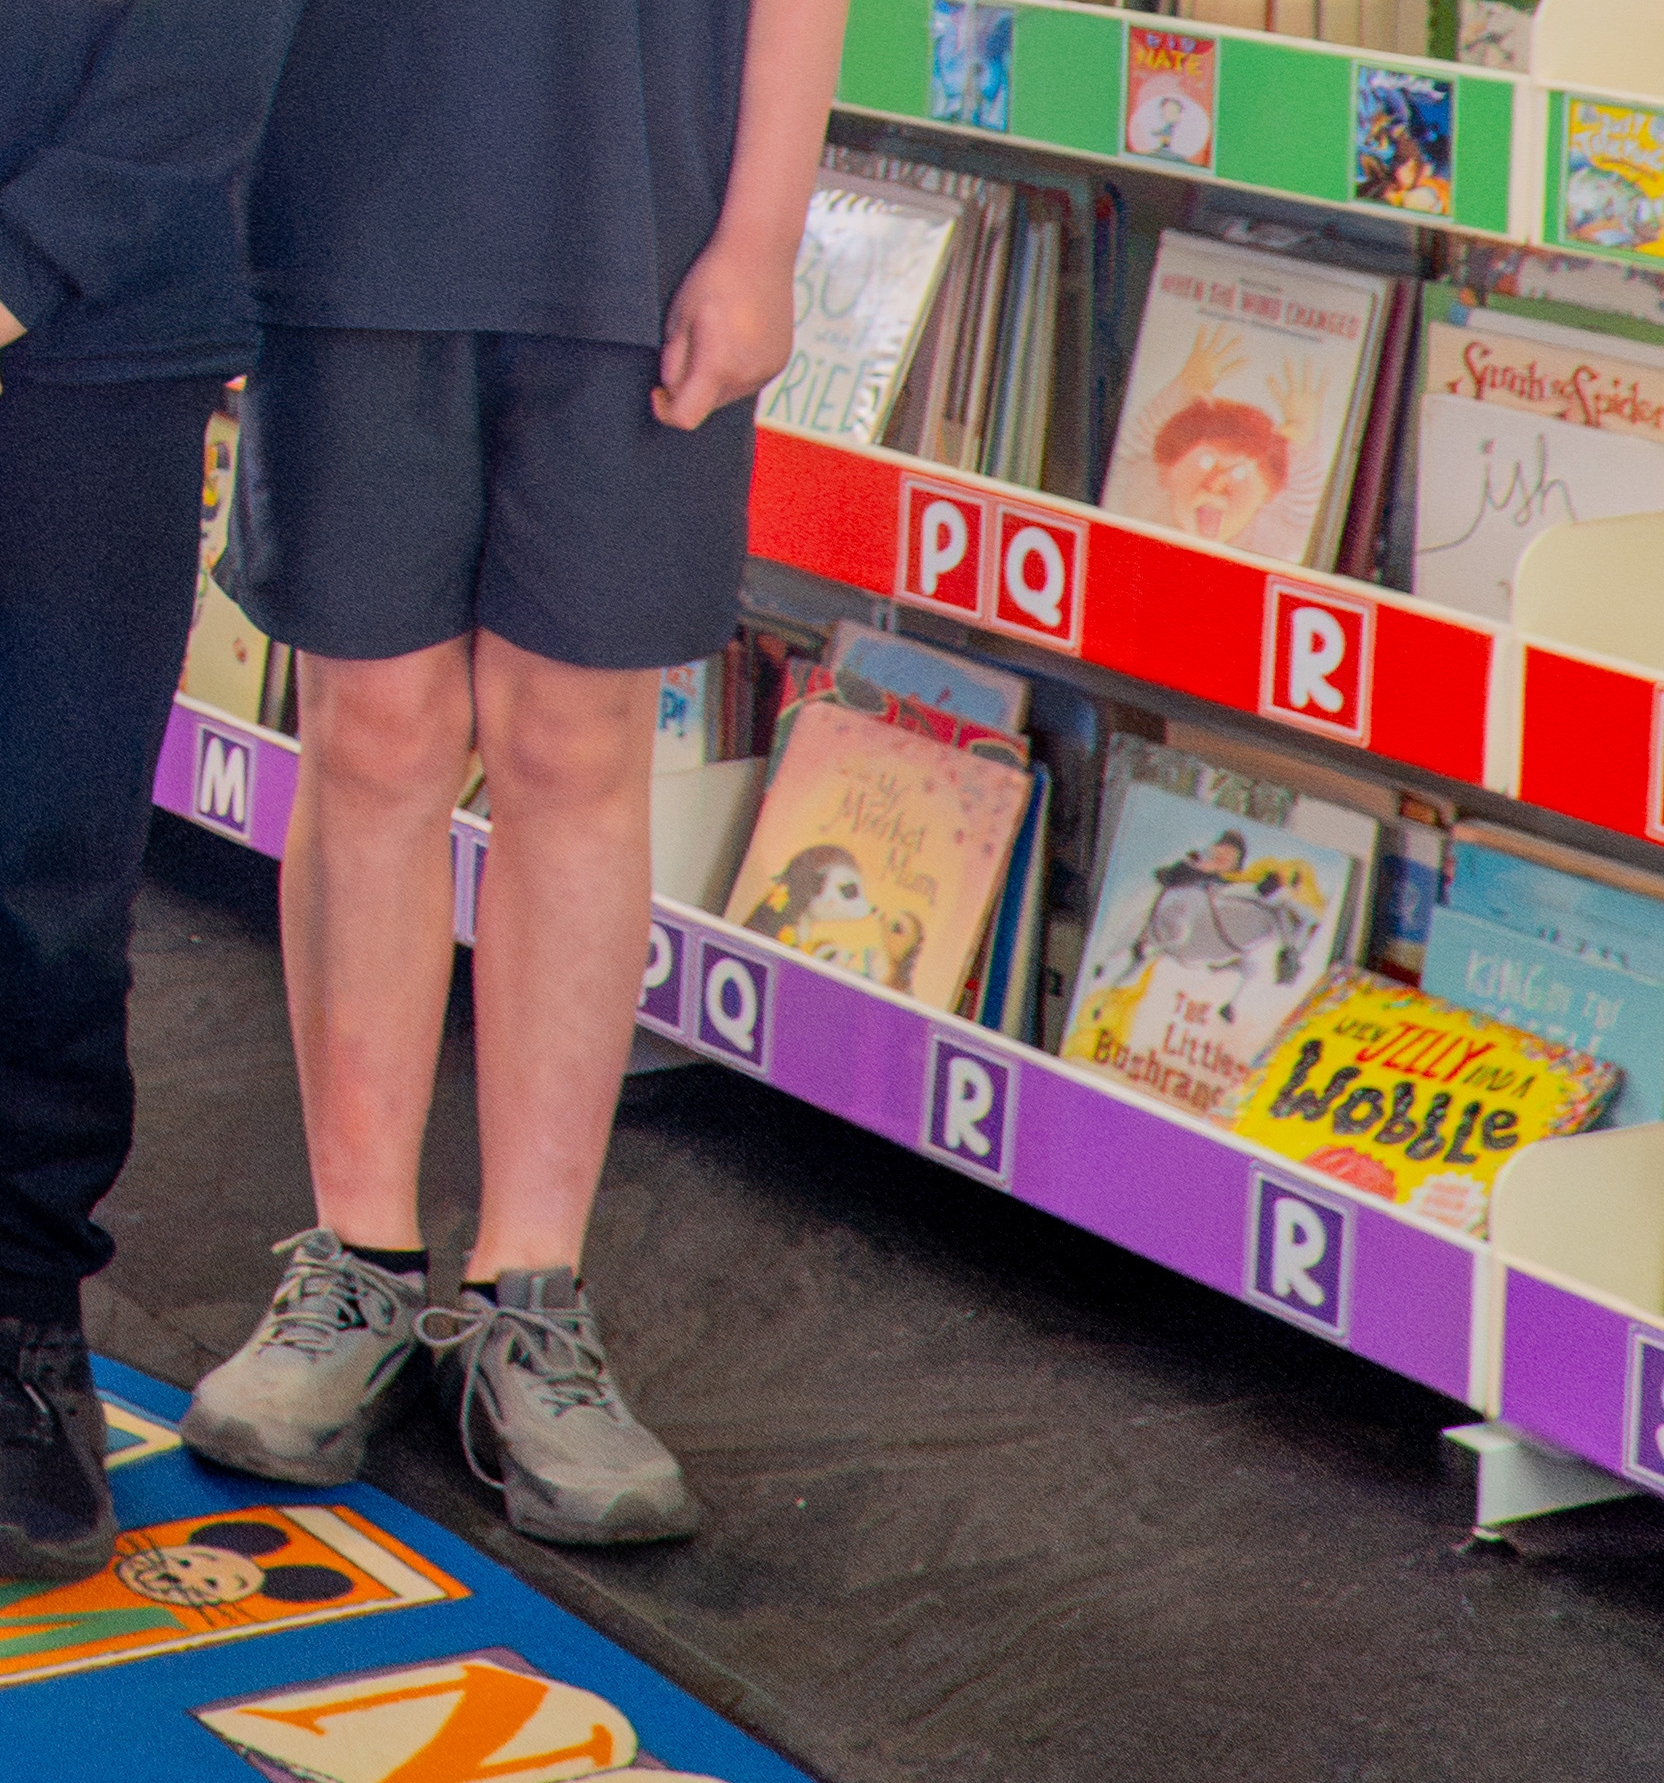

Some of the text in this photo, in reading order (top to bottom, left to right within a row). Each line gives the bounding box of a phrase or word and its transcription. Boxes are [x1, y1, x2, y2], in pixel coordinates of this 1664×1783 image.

[1133, 48, 1205, 76] NATE
[918, 500, 1068, 628] P Q
[1287, 605, 1347, 714] R
[198, 736, 249, 825] M
[704, 957, 758, 1054] Q
[1162, 1021, 1251, 1086] Littles
[943, 1055, 994, 1158] R
[1091, 1026, 1226, 1113] Bushran
[1269, 1038, 1521, 1166] Wobble
[1356, 1020, 1496, 1084] JELLY
[1509, 1073, 1539, 1100] A
[1271, 1196, 1327, 1308] R
[239, 1664, 618, 1783] N
